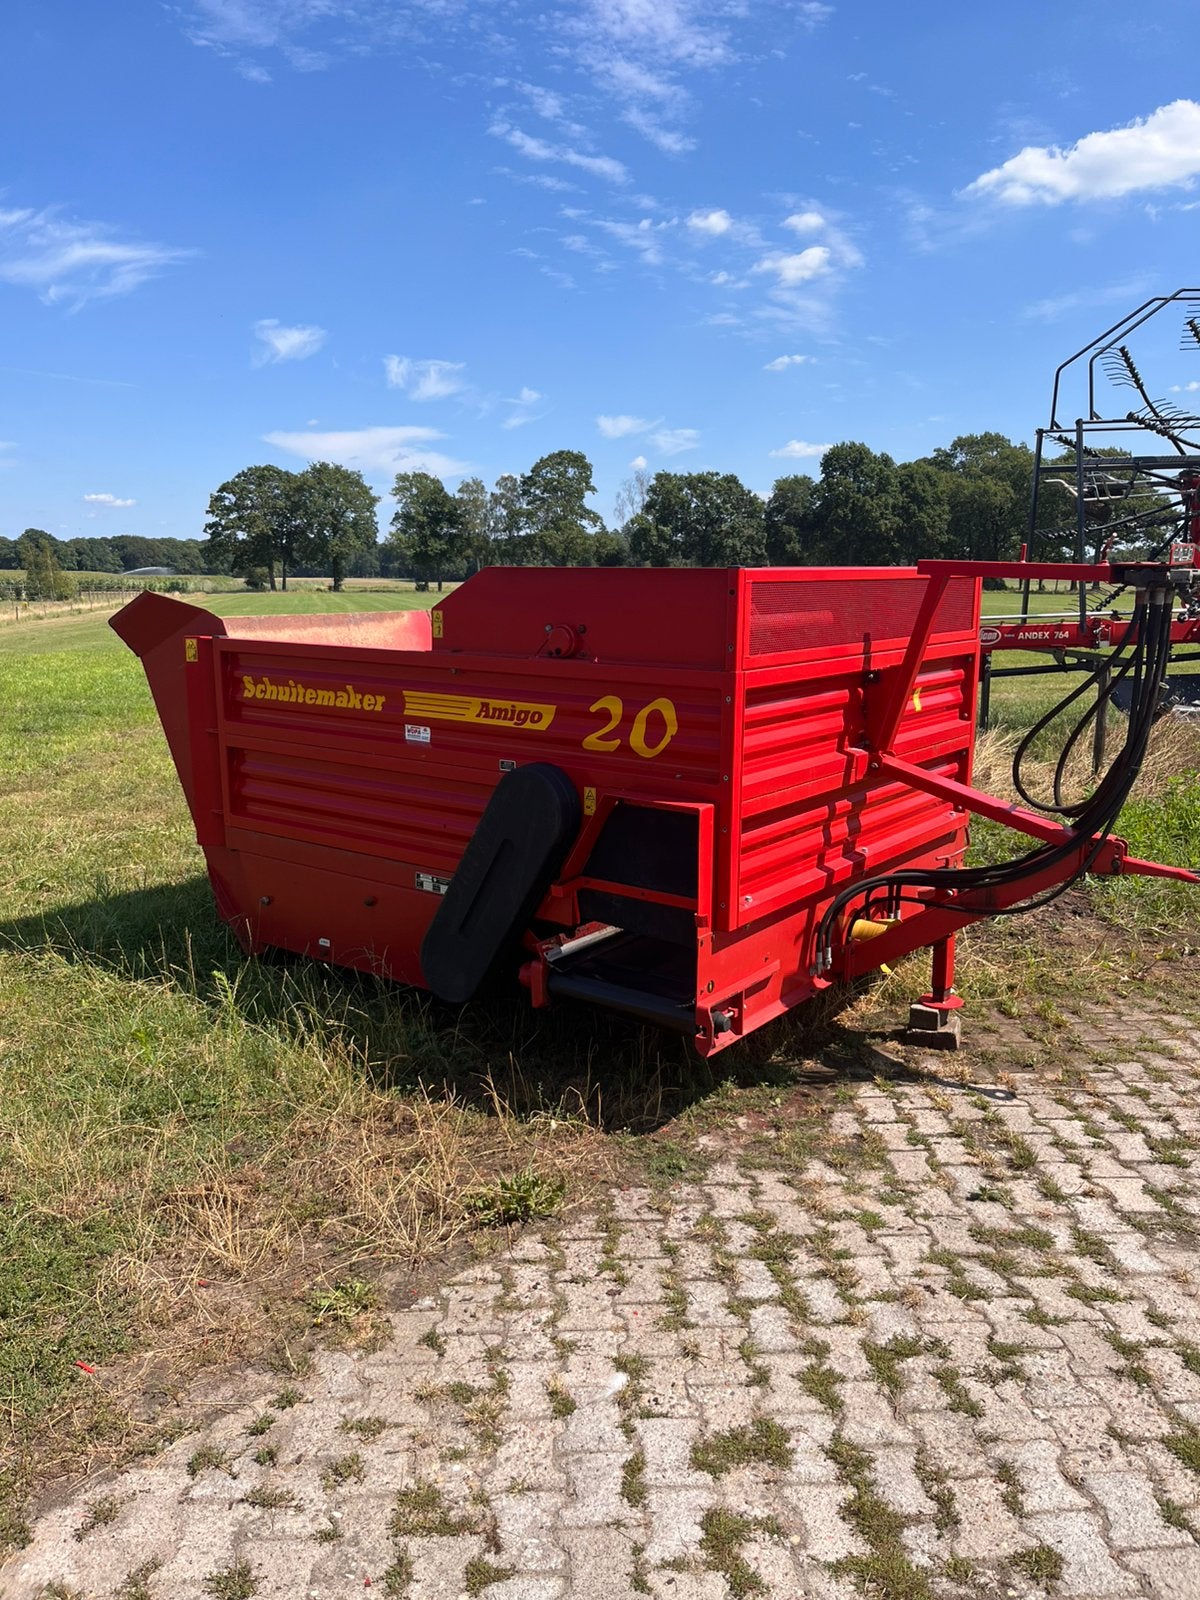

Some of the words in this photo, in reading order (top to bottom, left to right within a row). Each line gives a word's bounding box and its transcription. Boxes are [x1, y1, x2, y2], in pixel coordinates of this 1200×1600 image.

[980, 631, 997, 640] icon
[1018, 631, 1050, 639] ANDEX
[1053, 631, 1069, 639] 764
[242, 675, 386, 712] Schuitemaker
[475, 702, 543, 726] Amigo
[581, 695, 678, 758] 20
